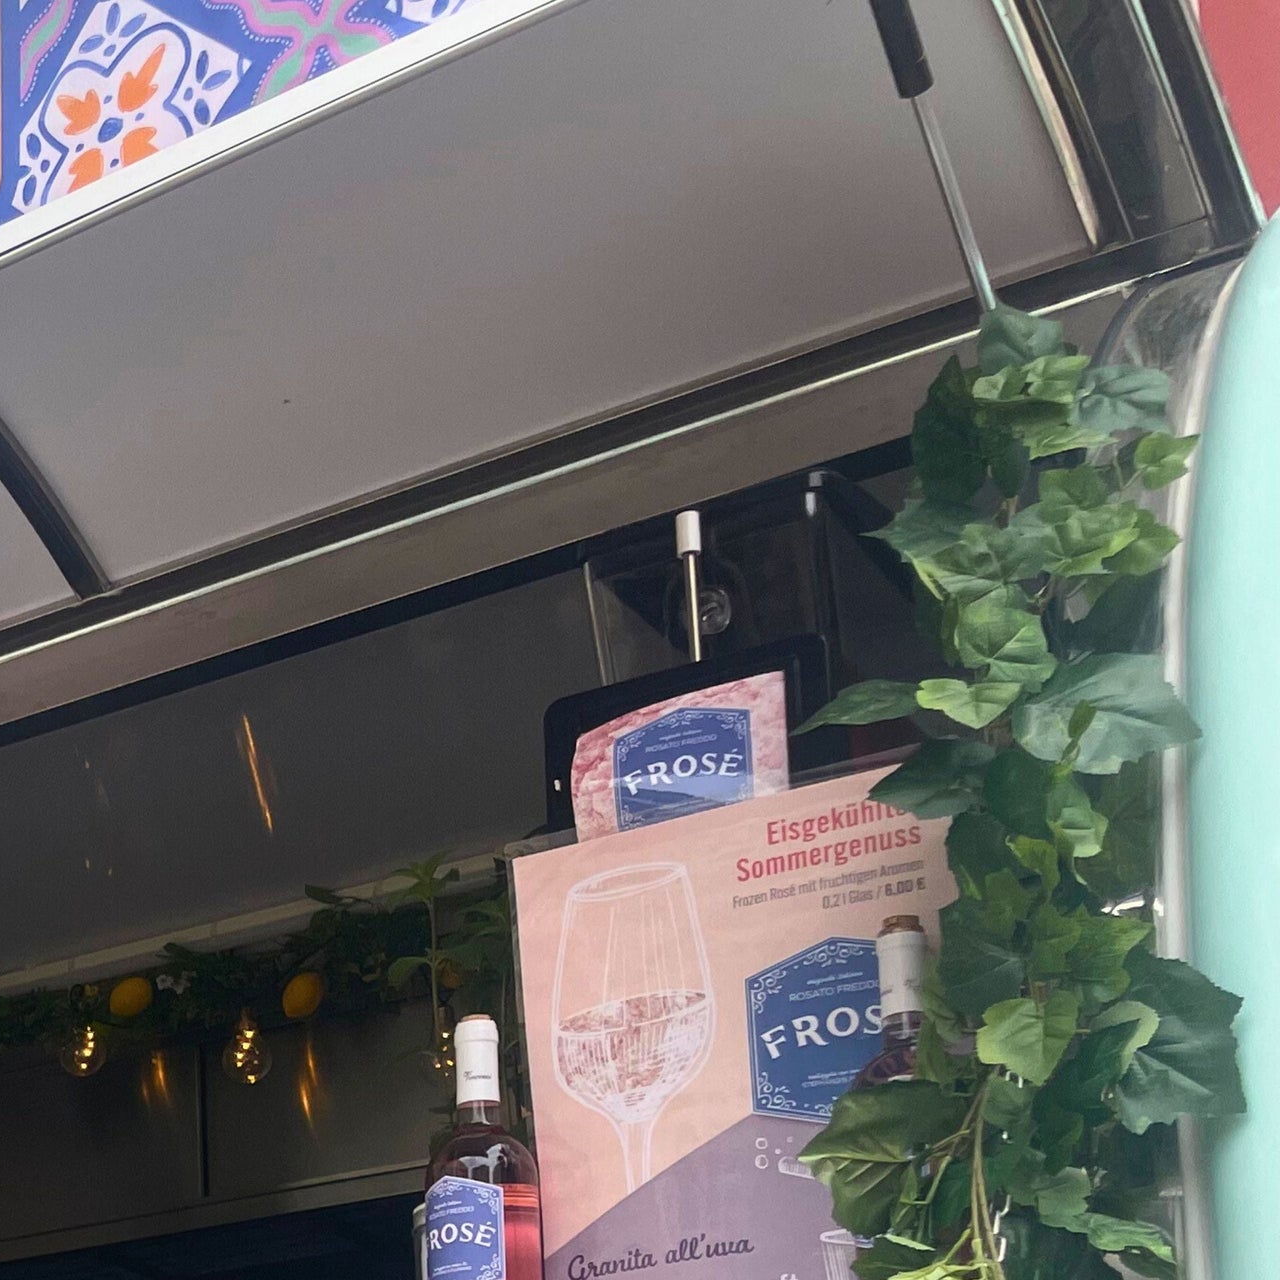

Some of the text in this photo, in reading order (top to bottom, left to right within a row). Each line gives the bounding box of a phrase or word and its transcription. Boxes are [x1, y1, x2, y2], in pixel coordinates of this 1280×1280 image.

[624, 748, 743, 796] FROSÉ
[766, 800, 906, 846] Eisgekühlt
[736, 825, 922, 882] Sommergenuss
[732, 859, 924, 909] Frozen Rosé mit fruchtigen Aromen
[849, 889, 873, 905] Glas
[789, 986, 834, 1002] ROSATO
[760, 1004, 883, 1060] FROS
[428, 1221, 497, 1251] ROSÉ
[665, 1233, 755, 1264] all'uva
